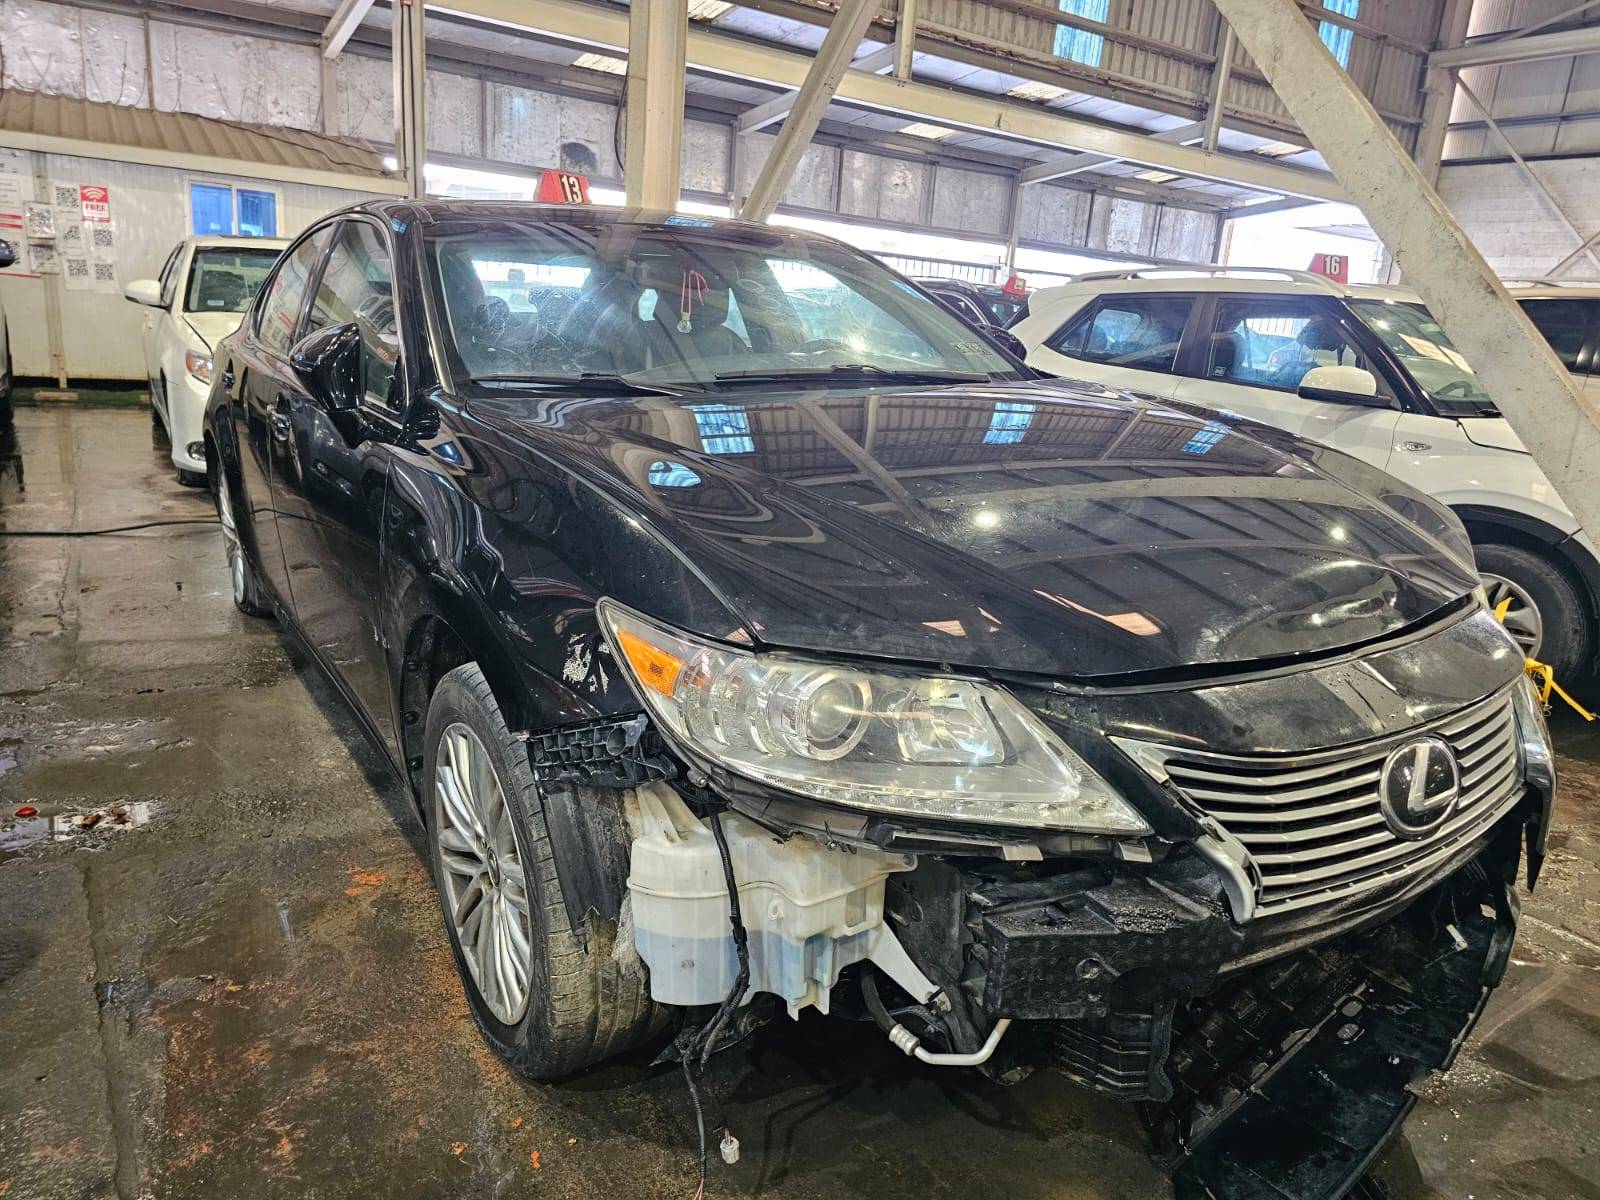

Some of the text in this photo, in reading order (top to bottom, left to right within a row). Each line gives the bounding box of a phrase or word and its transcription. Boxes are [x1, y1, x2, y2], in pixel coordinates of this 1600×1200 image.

[560, 174, 583, 204] 13
[85, 203, 106, 212] FREE
[1324, 255, 1341, 275] 16
